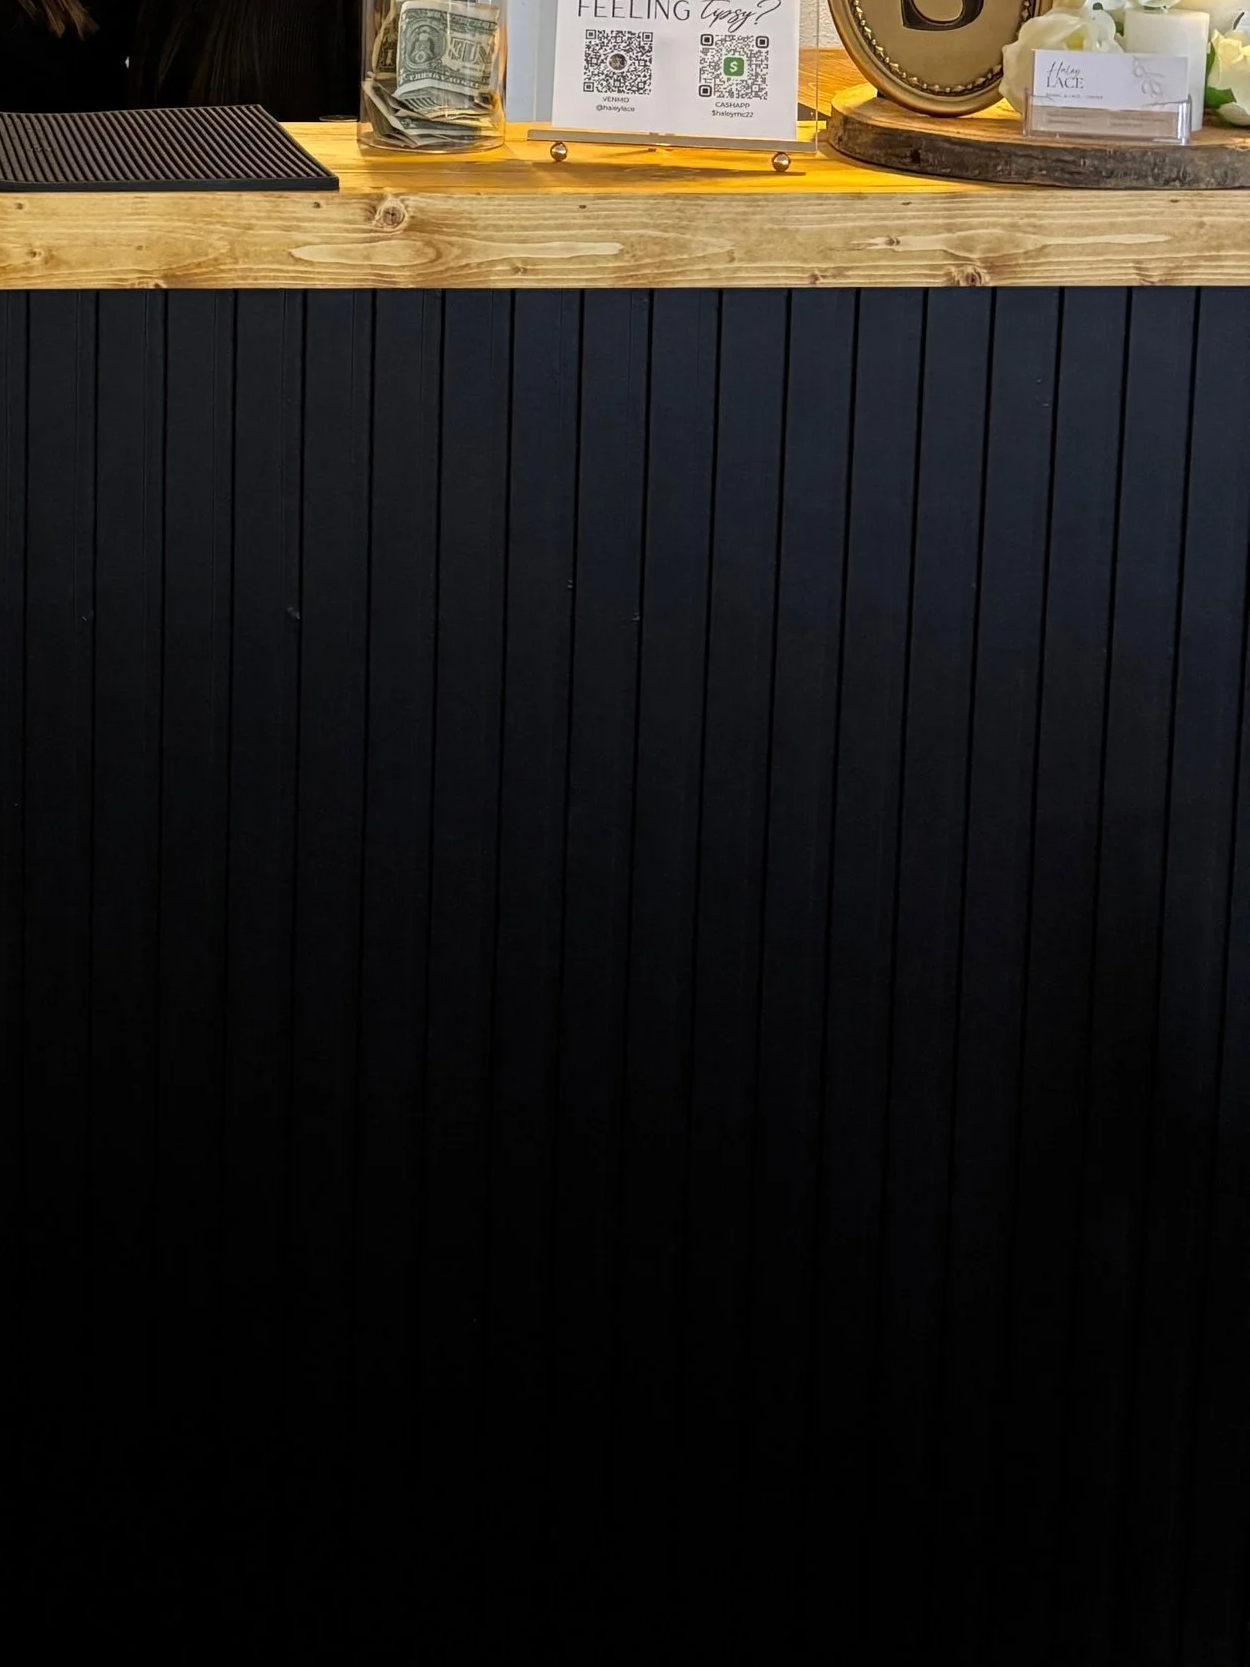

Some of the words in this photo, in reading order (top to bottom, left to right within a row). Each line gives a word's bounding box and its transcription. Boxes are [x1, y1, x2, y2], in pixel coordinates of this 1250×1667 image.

[1046, 61, 1081, 78] Haley
[1046, 76, 1084, 89] LACE
[602, 96, 630, 104] VENMO
[715, 101, 751, 109] CASHAPP
